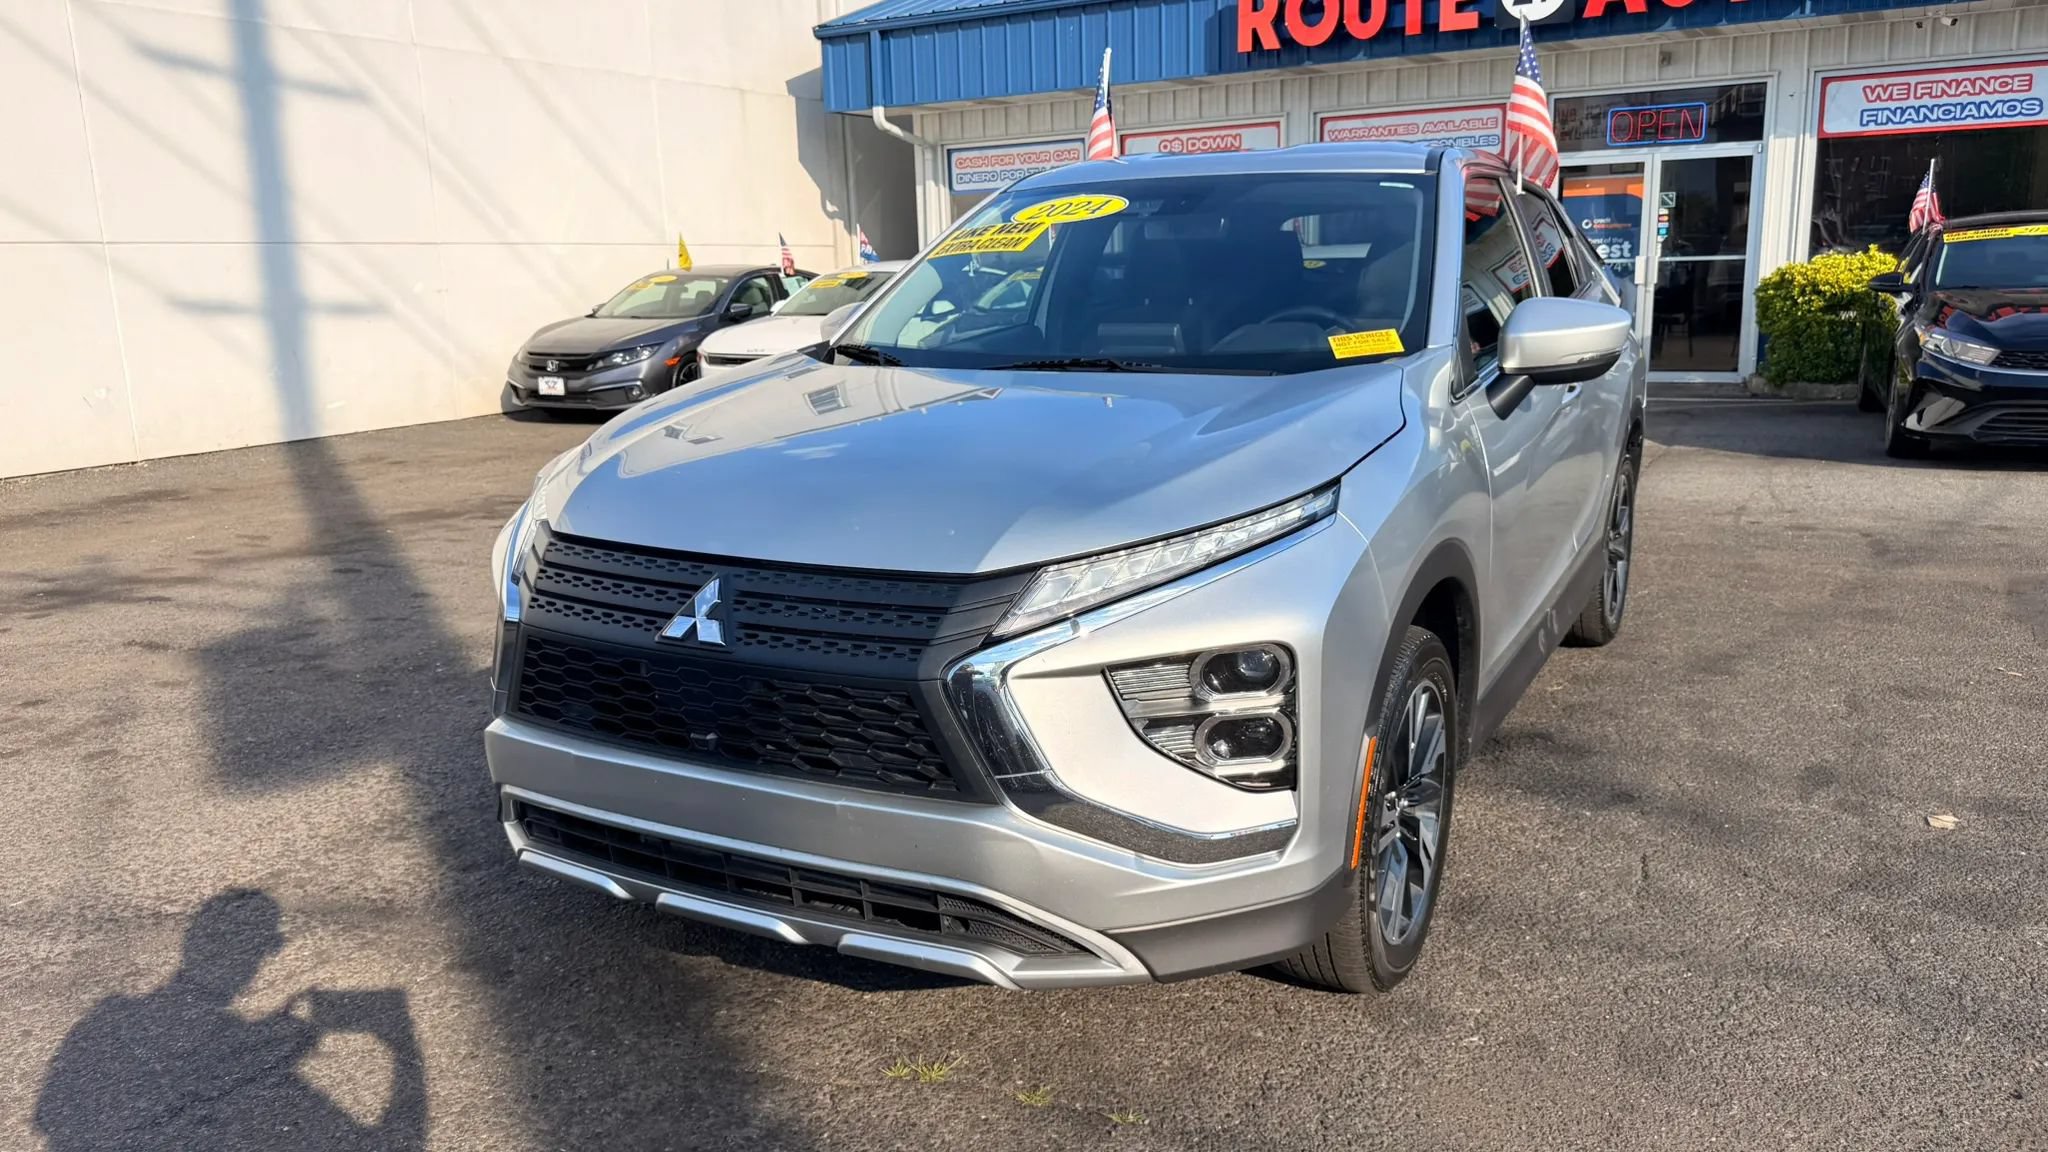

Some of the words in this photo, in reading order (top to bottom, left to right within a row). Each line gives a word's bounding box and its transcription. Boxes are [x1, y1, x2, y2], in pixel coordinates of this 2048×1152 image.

[1862, 83, 1911, 103] WE
[1914, 73, 2033, 99] FINANCE
[1860, 97, 2043, 127] FINANCIAMOS
[1328, 123, 1419, 140] WARRANTIES
[1422, 117, 1498, 134] AVAILABLE
[1611, 108, 1703, 142] OPEN
[1186, 134, 1242, 152] DOWN
[956, 156, 989, 169] CASH
[990, 154, 1015, 167] FOR
[1016, 151, 1051, 165] YOUR
[1052, 148, 1080, 162] CAR
[956, 170, 998, 185] DINERO
[1000, 168, 1025, 181] POR
[1028, 199, 1113, 220] 2024
[951, 224, 995, 240] LIKE
[990, 222, 1046, 236] NEW
[976, 236, 1029, 250] CLEAN
[1596, 240, 1632, 259] est
